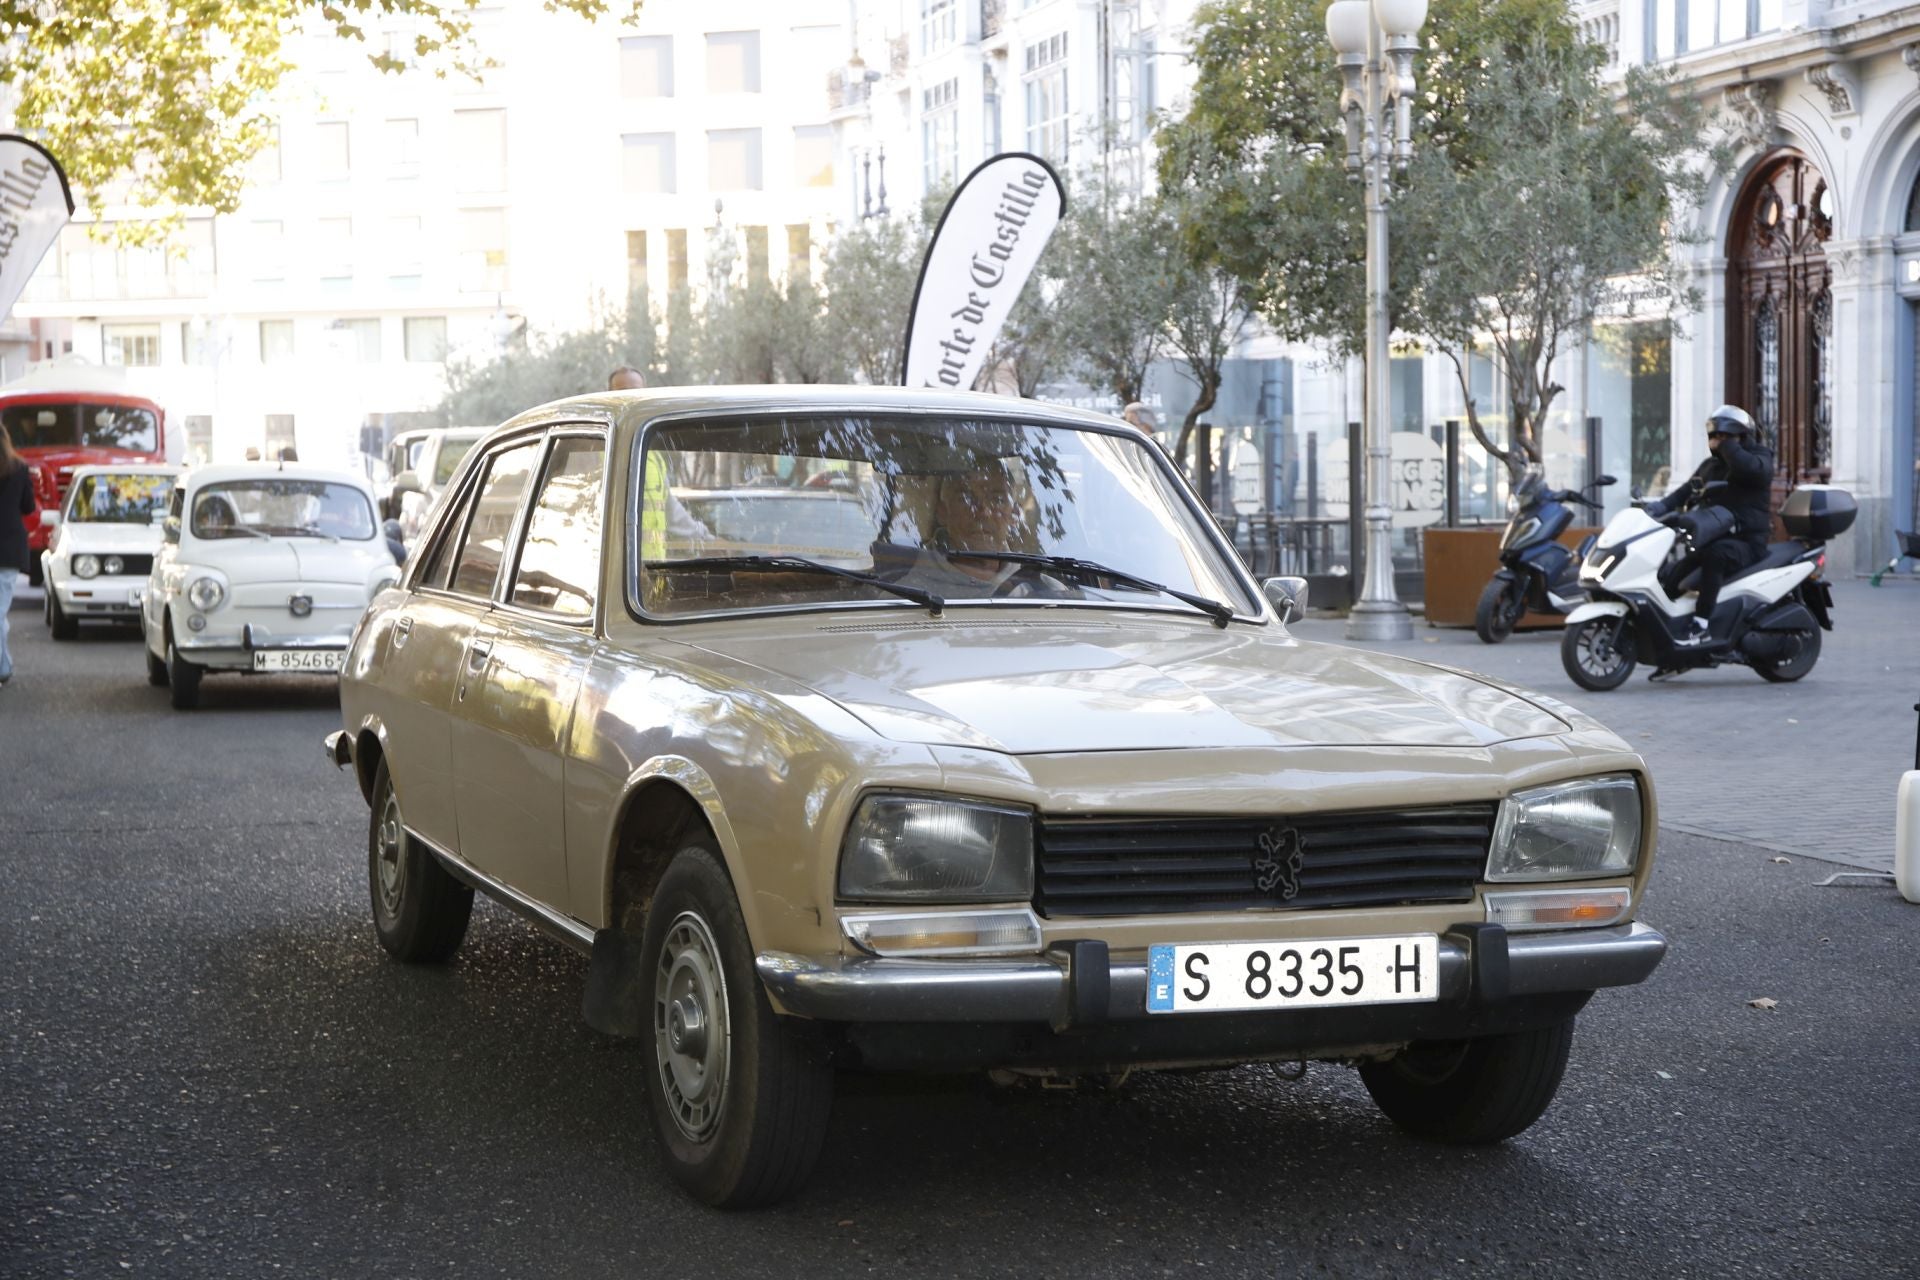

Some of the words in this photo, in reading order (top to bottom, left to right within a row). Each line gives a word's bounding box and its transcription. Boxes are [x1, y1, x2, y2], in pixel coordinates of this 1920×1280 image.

[970, 170, 1048, 288] Castilla
[951, 291, 990, 325] de
[925, 327, 976, 388] orte
[1392, 460, 1444, 481] RGER
[1392, 480, 1444, 509] ING
[1156, 984, 1168, 999] E
[1183, 952, 1210, 1002] S
[1245, 946, 1364, 999] 8335
[1395, 944, 1421, 993] H
